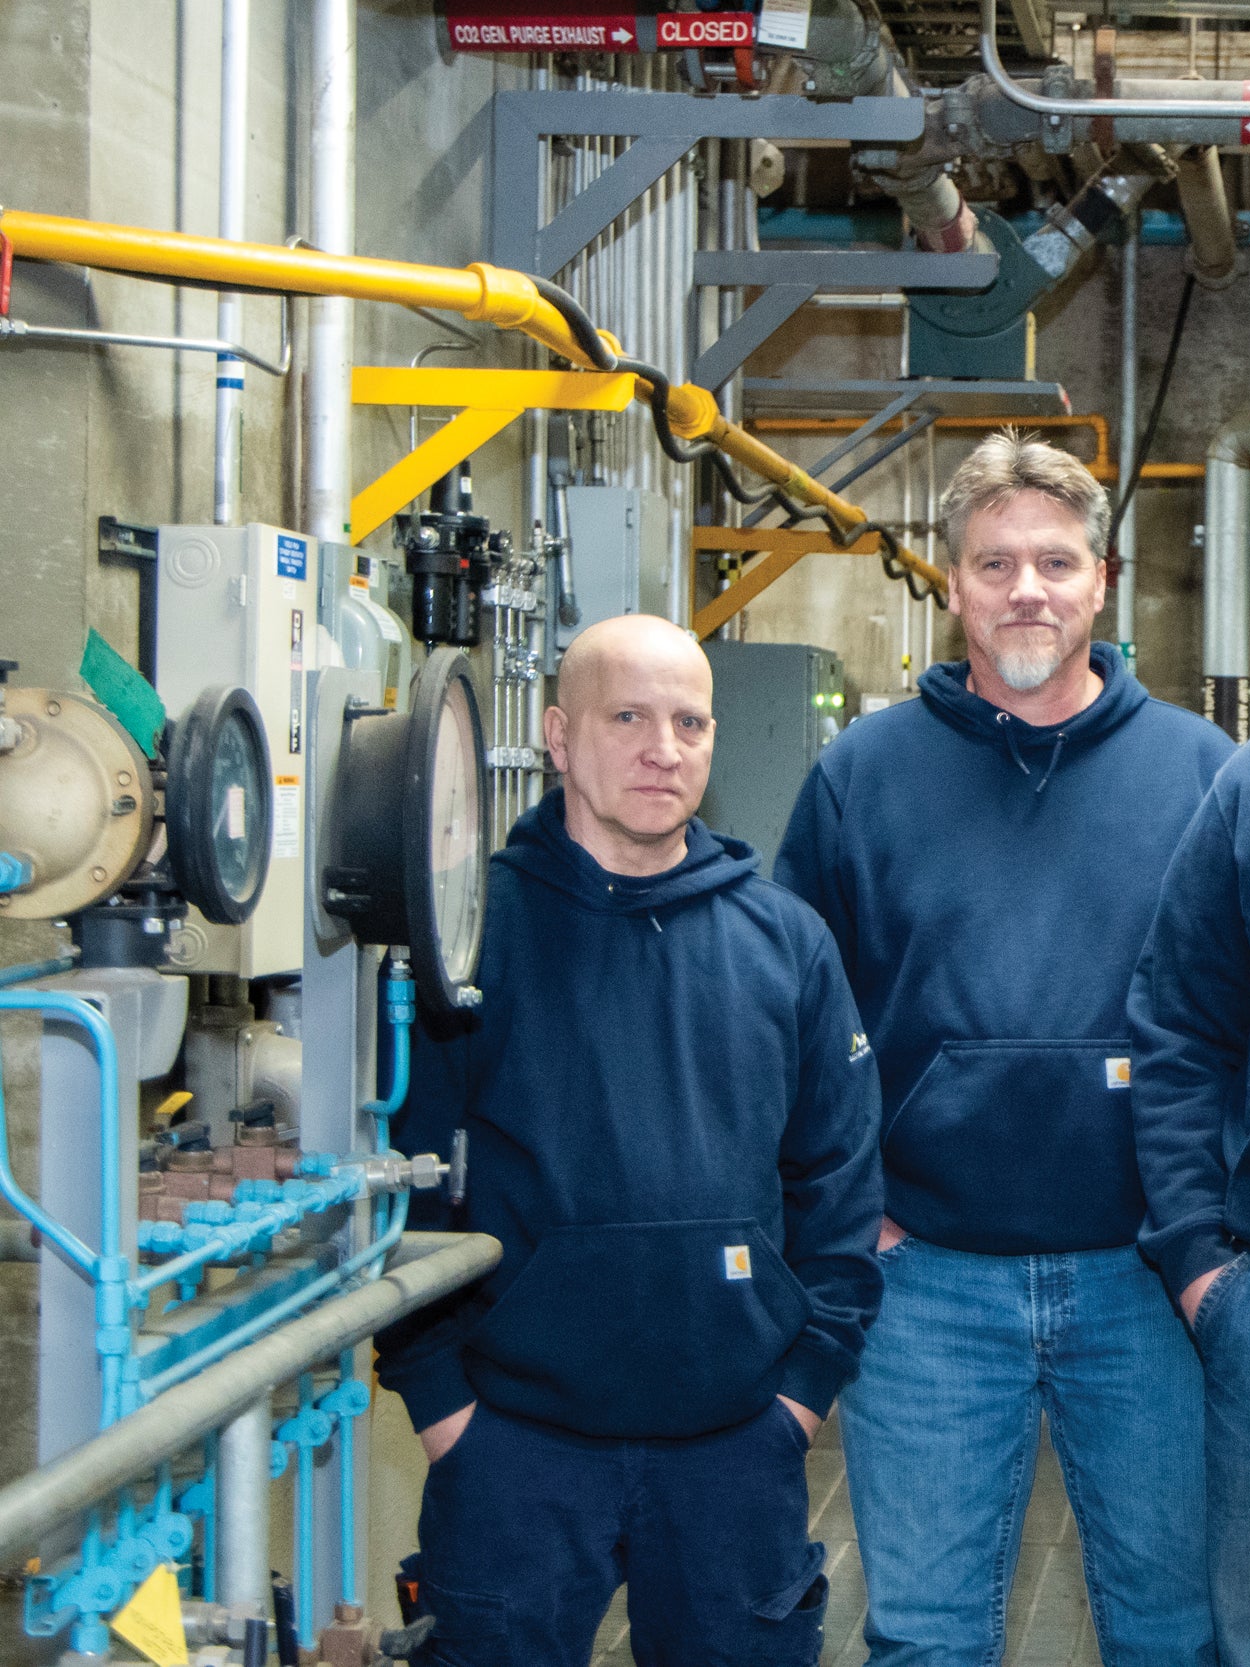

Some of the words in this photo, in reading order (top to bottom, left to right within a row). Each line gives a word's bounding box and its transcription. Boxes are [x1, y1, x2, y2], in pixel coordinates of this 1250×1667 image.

[455, 25, 480, 43] CO2
[481, 25, 509, 43] GEN.
[510, 26, 550, 44] PURGE
[552, 26, 606, 44] EXHAUST
[661, 21, 748, 42] CLOSED
